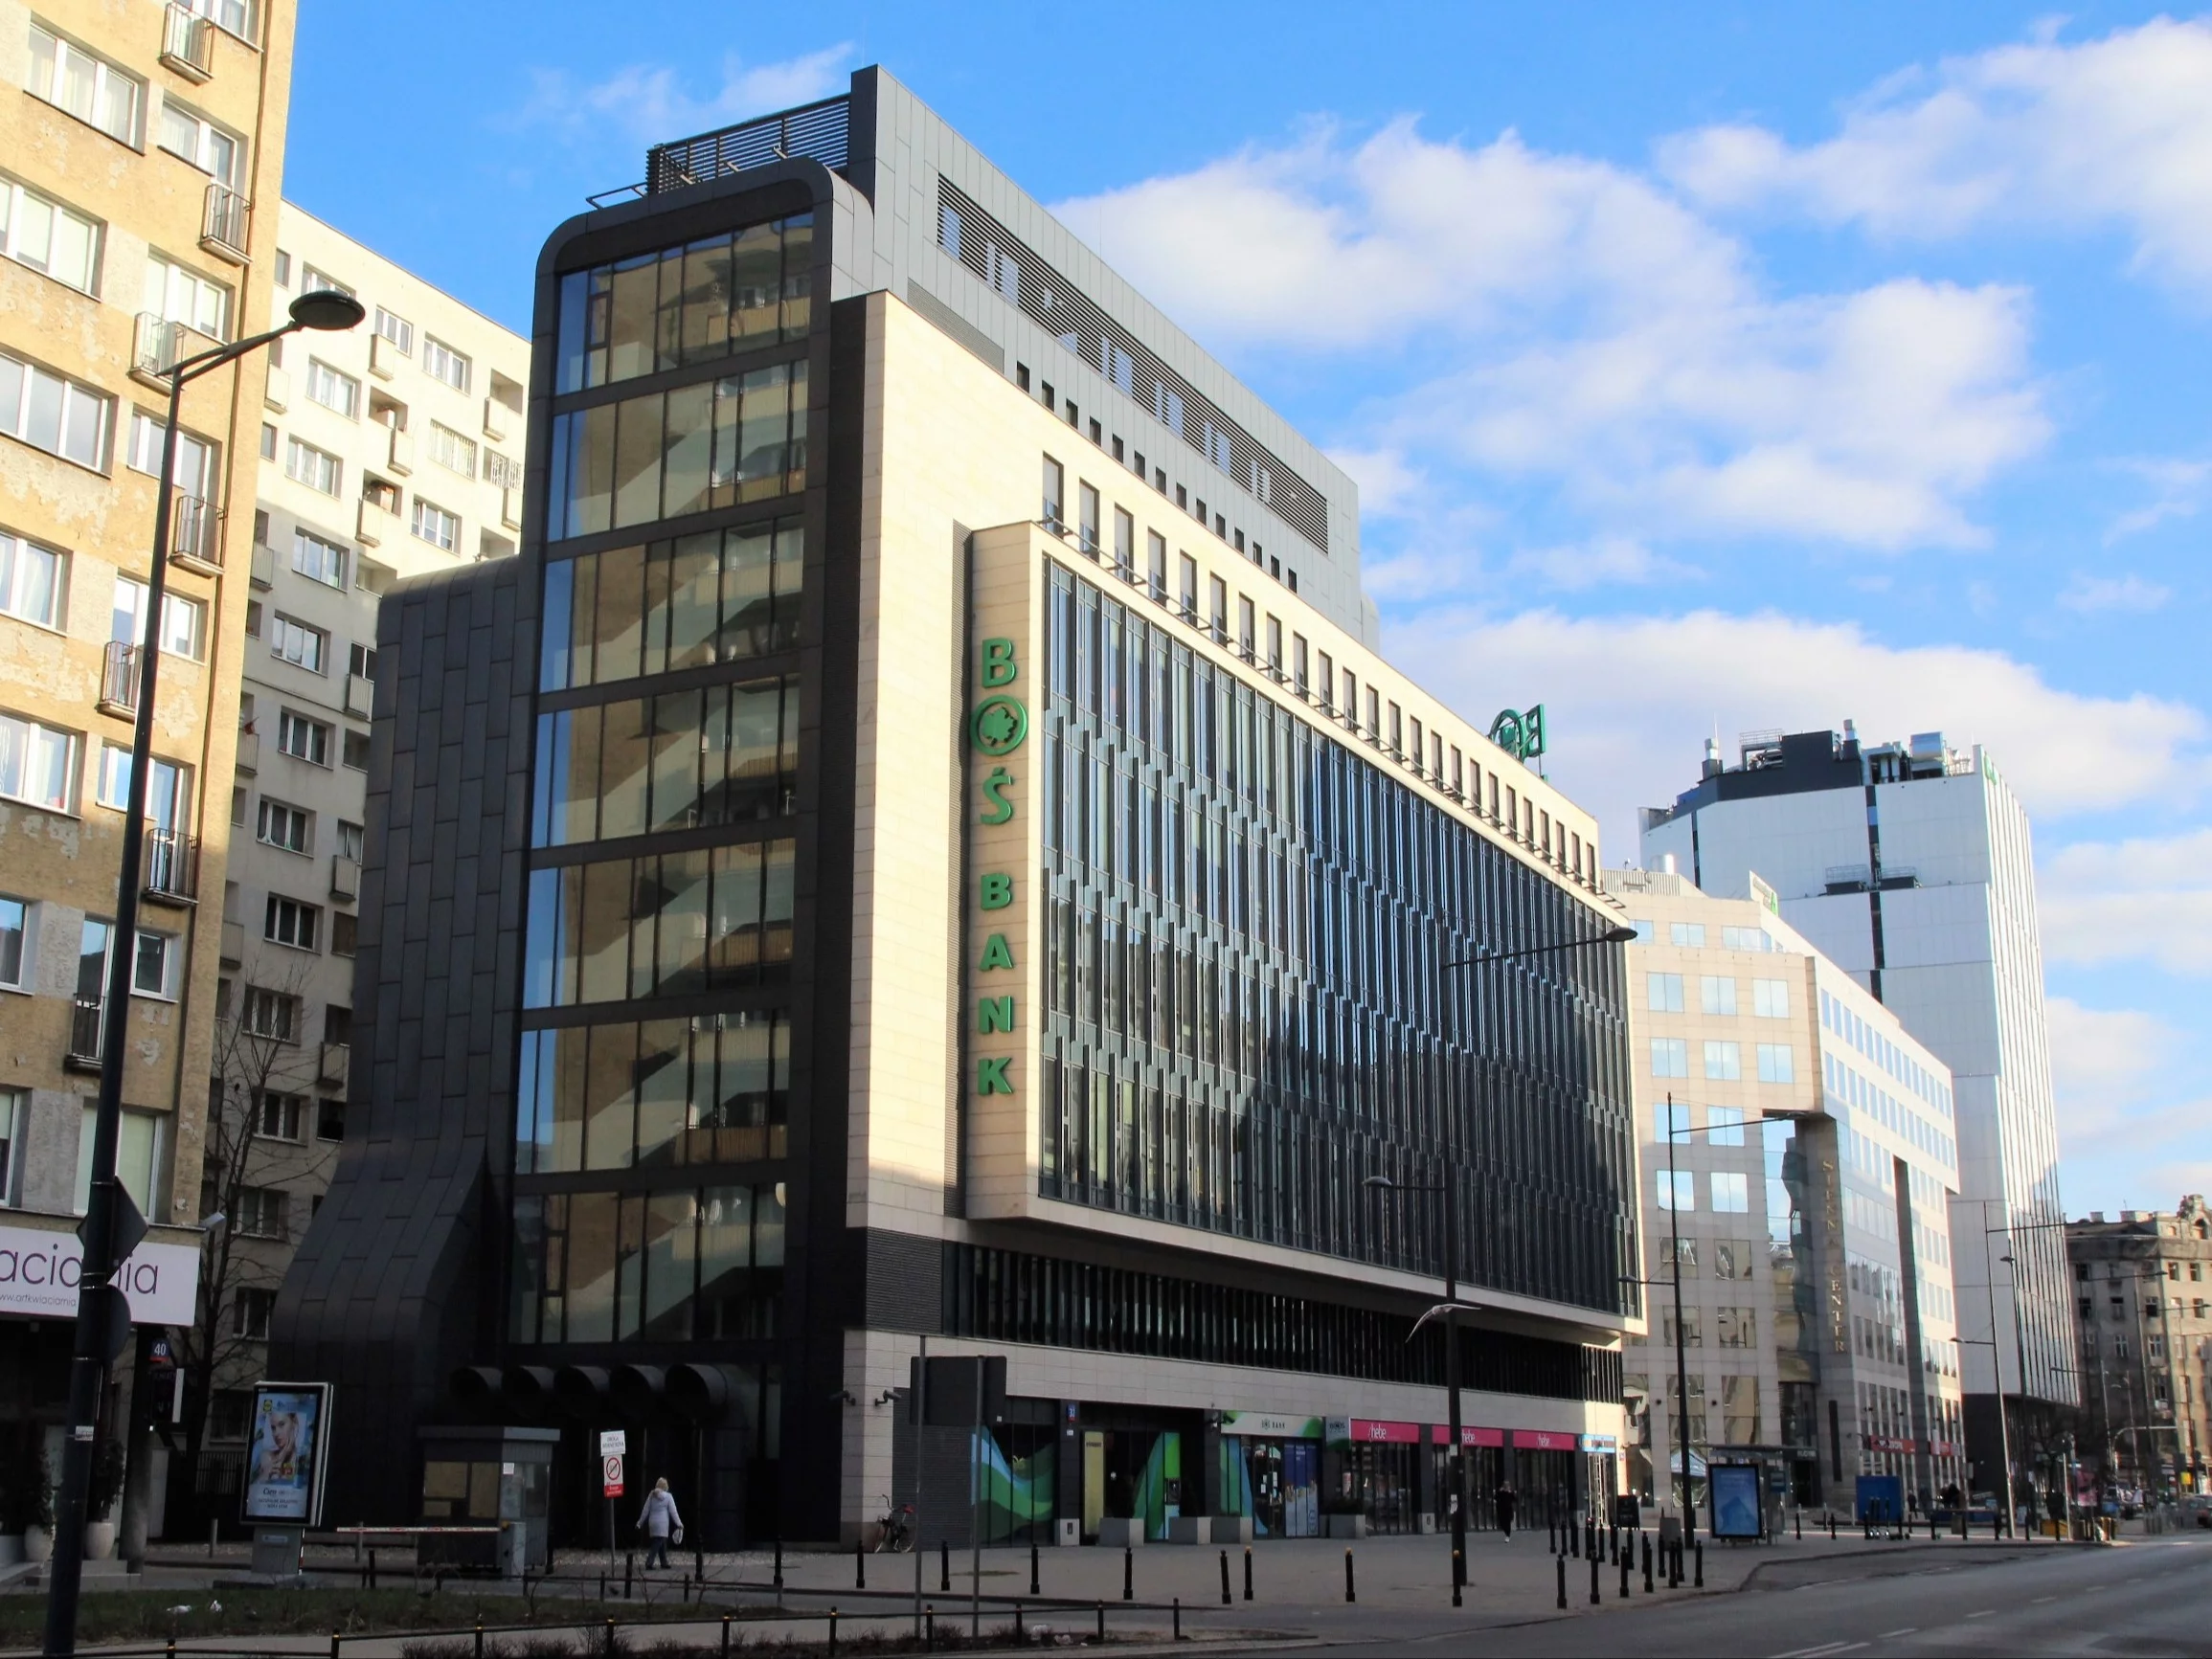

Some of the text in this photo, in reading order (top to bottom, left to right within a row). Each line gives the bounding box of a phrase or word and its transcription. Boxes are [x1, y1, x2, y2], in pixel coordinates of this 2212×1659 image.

[978, 873, 1014, 1096] BANK
[1829, 1266, 1845, 1353] CENTER
[153, 1342, 167, 1356] 40
[1368, 1424, 1387, 1442] hebe
[1461, 1427, 1476, 1444] hebe
[1537, 1432, 1550, 1448] hebe
